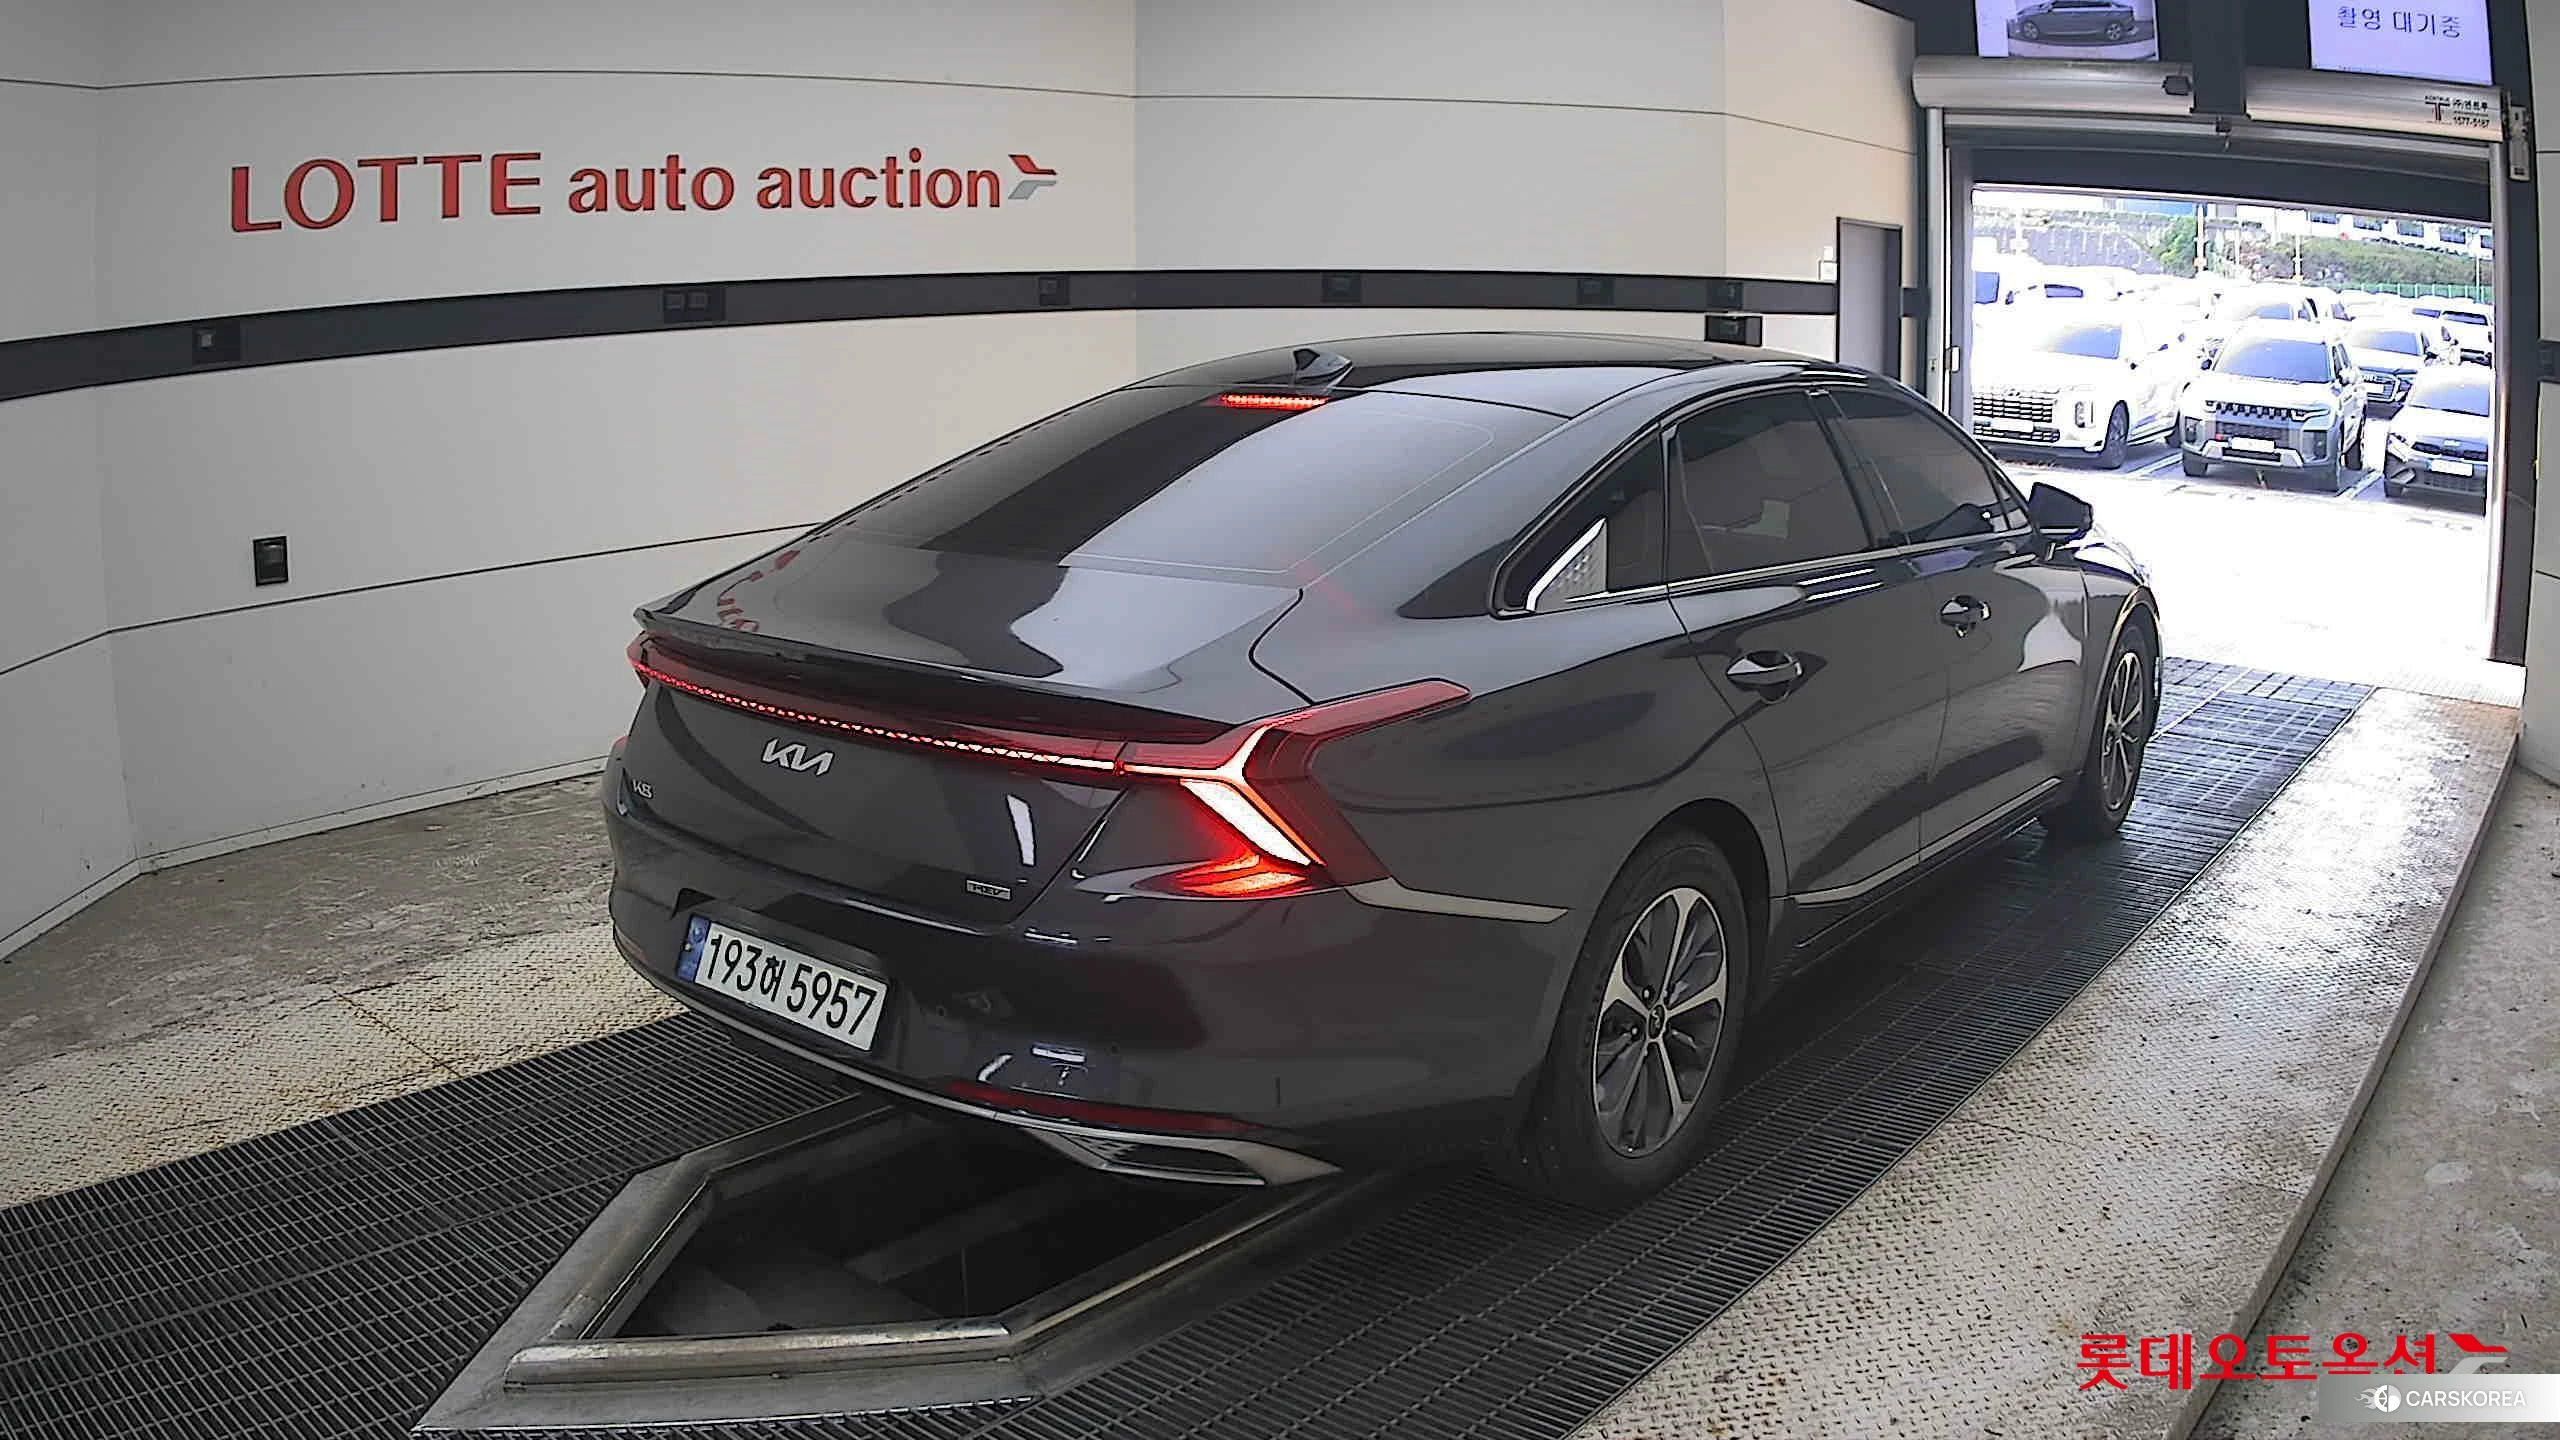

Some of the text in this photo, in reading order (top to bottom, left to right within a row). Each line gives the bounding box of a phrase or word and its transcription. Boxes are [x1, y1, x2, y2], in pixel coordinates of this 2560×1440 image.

[2338, 6, 2381, 30] 촬영
[231, 147, 1001, 232] LOTTE auto auction
[632, 779, 653, 799] K8
[786, 963, 878, 1035] 5957
